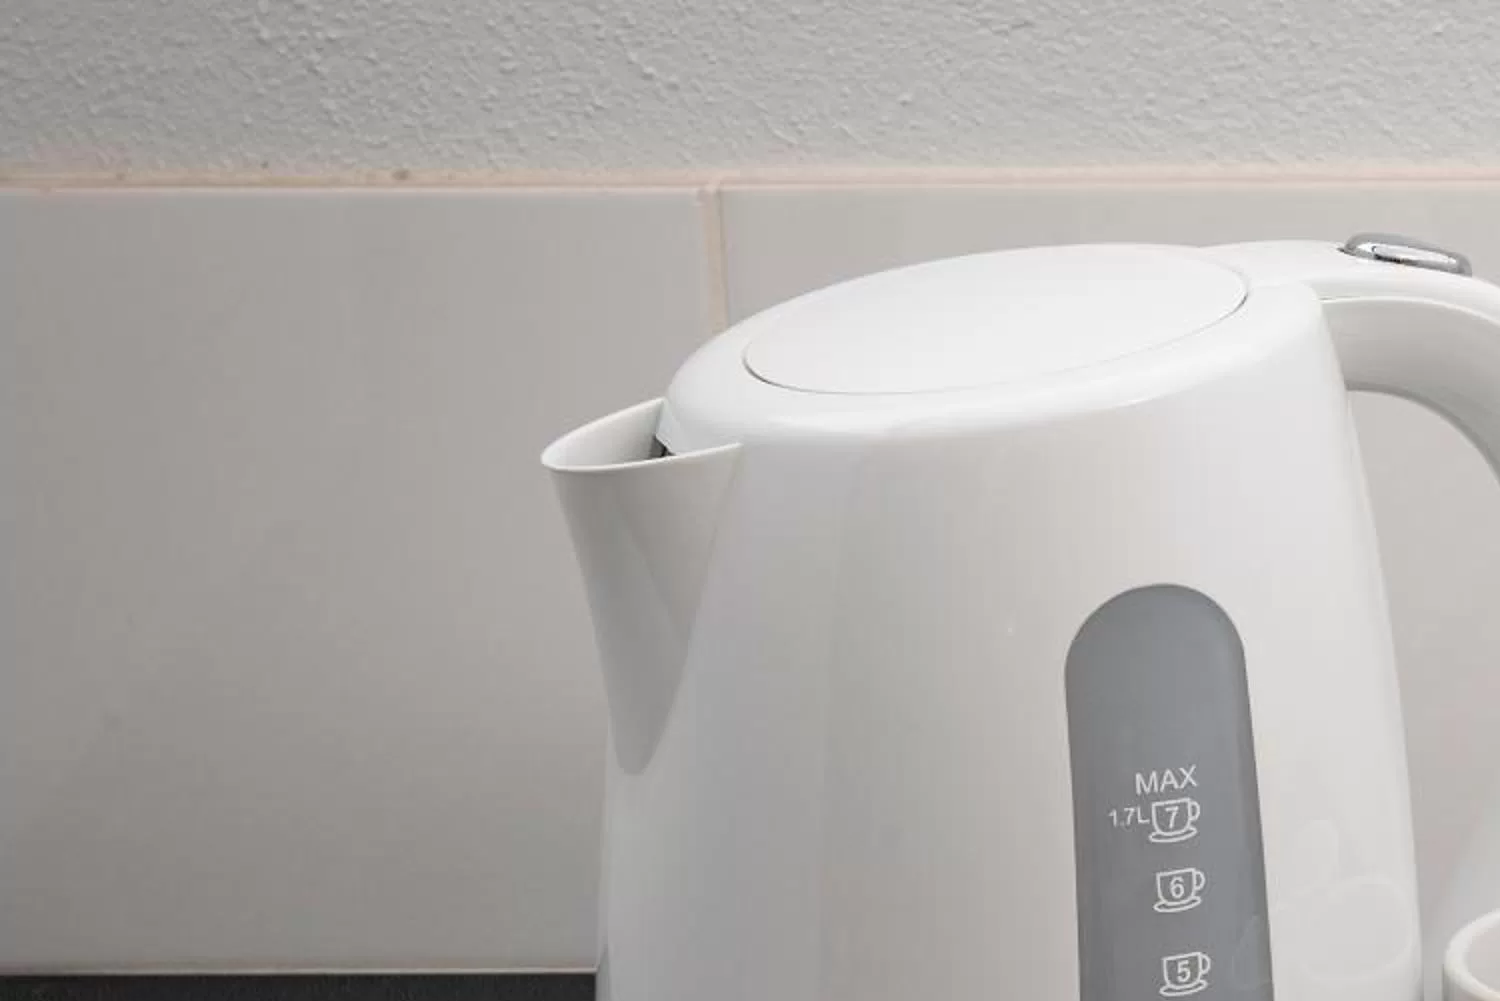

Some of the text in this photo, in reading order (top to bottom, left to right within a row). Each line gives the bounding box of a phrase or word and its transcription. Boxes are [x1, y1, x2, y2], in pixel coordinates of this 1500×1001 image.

[1135, 764, 1198, 796] MAX
[1108, 806, 1151, 828] 1.7L
[1165, 806, 1179, 828] 7
[1170, 877, 1185, 898] 6
[1177, 960, 1191, 983] 5
